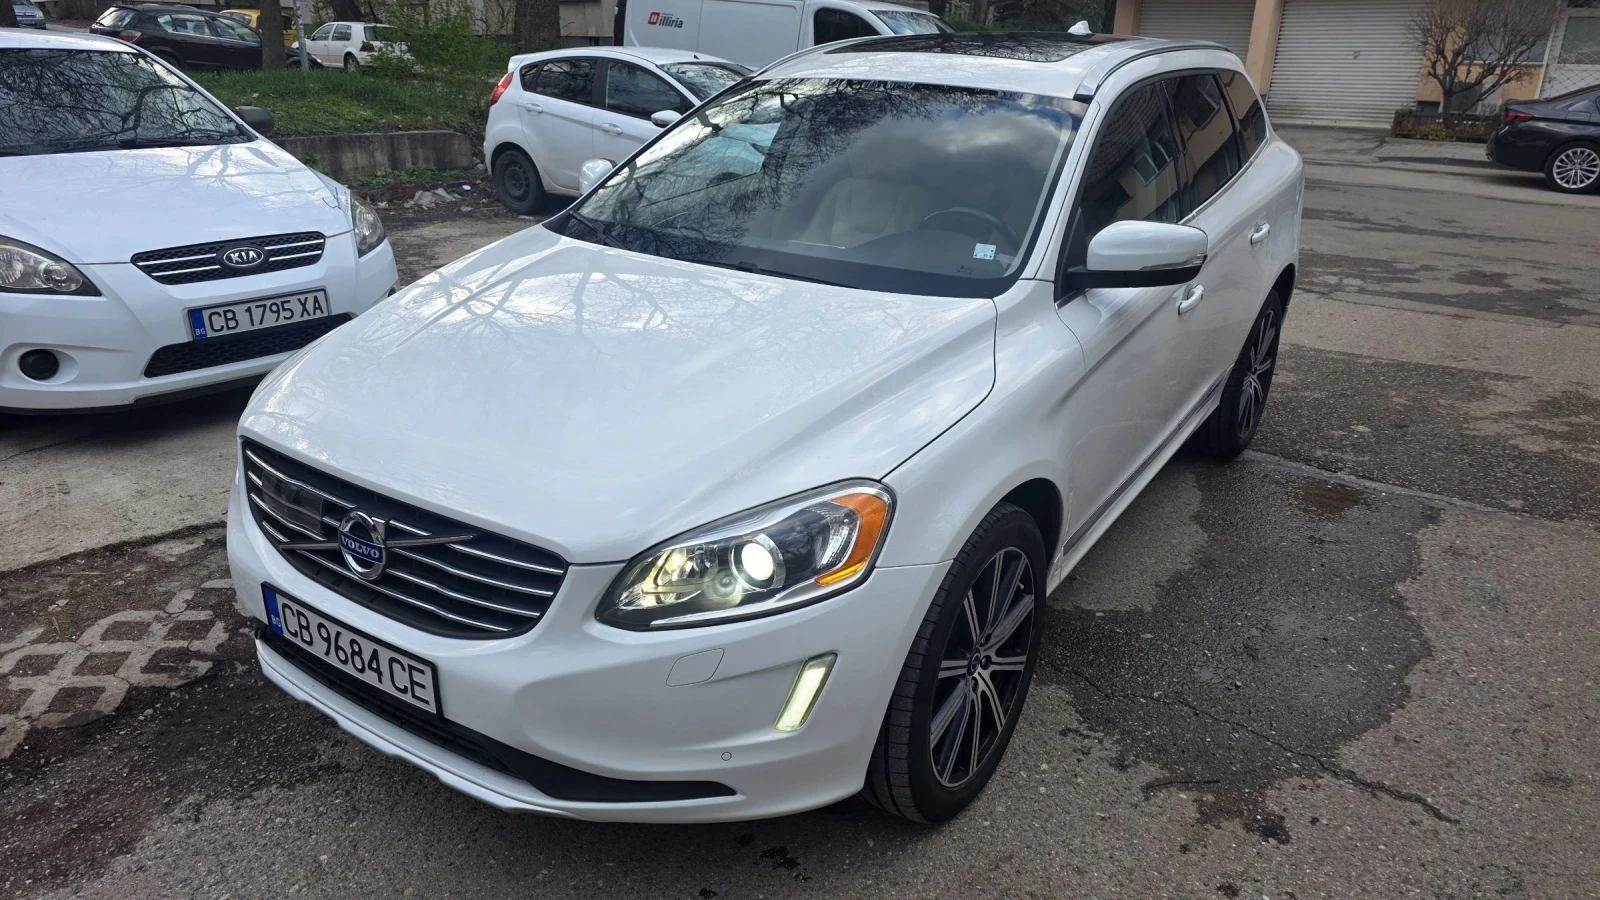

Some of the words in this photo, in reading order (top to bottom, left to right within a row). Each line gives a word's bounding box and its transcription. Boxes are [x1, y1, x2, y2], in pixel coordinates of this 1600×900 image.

[658, 15, 684, 28] illiria
[229, 250, 258, 264] KIA
[207, 308, 240, 333] CB
[244, 299, 295, 327] 1795
[296, 294, 325, 319] XA
[195, 328, 206, 336] BG
[341, 535, 380, 560] VOLVO
[271, 615, 282, 628] BG
[281, 602, 314, 647] CB
[316, 621, 384, 685] 9684
[388, 655, 431, 706] CE
